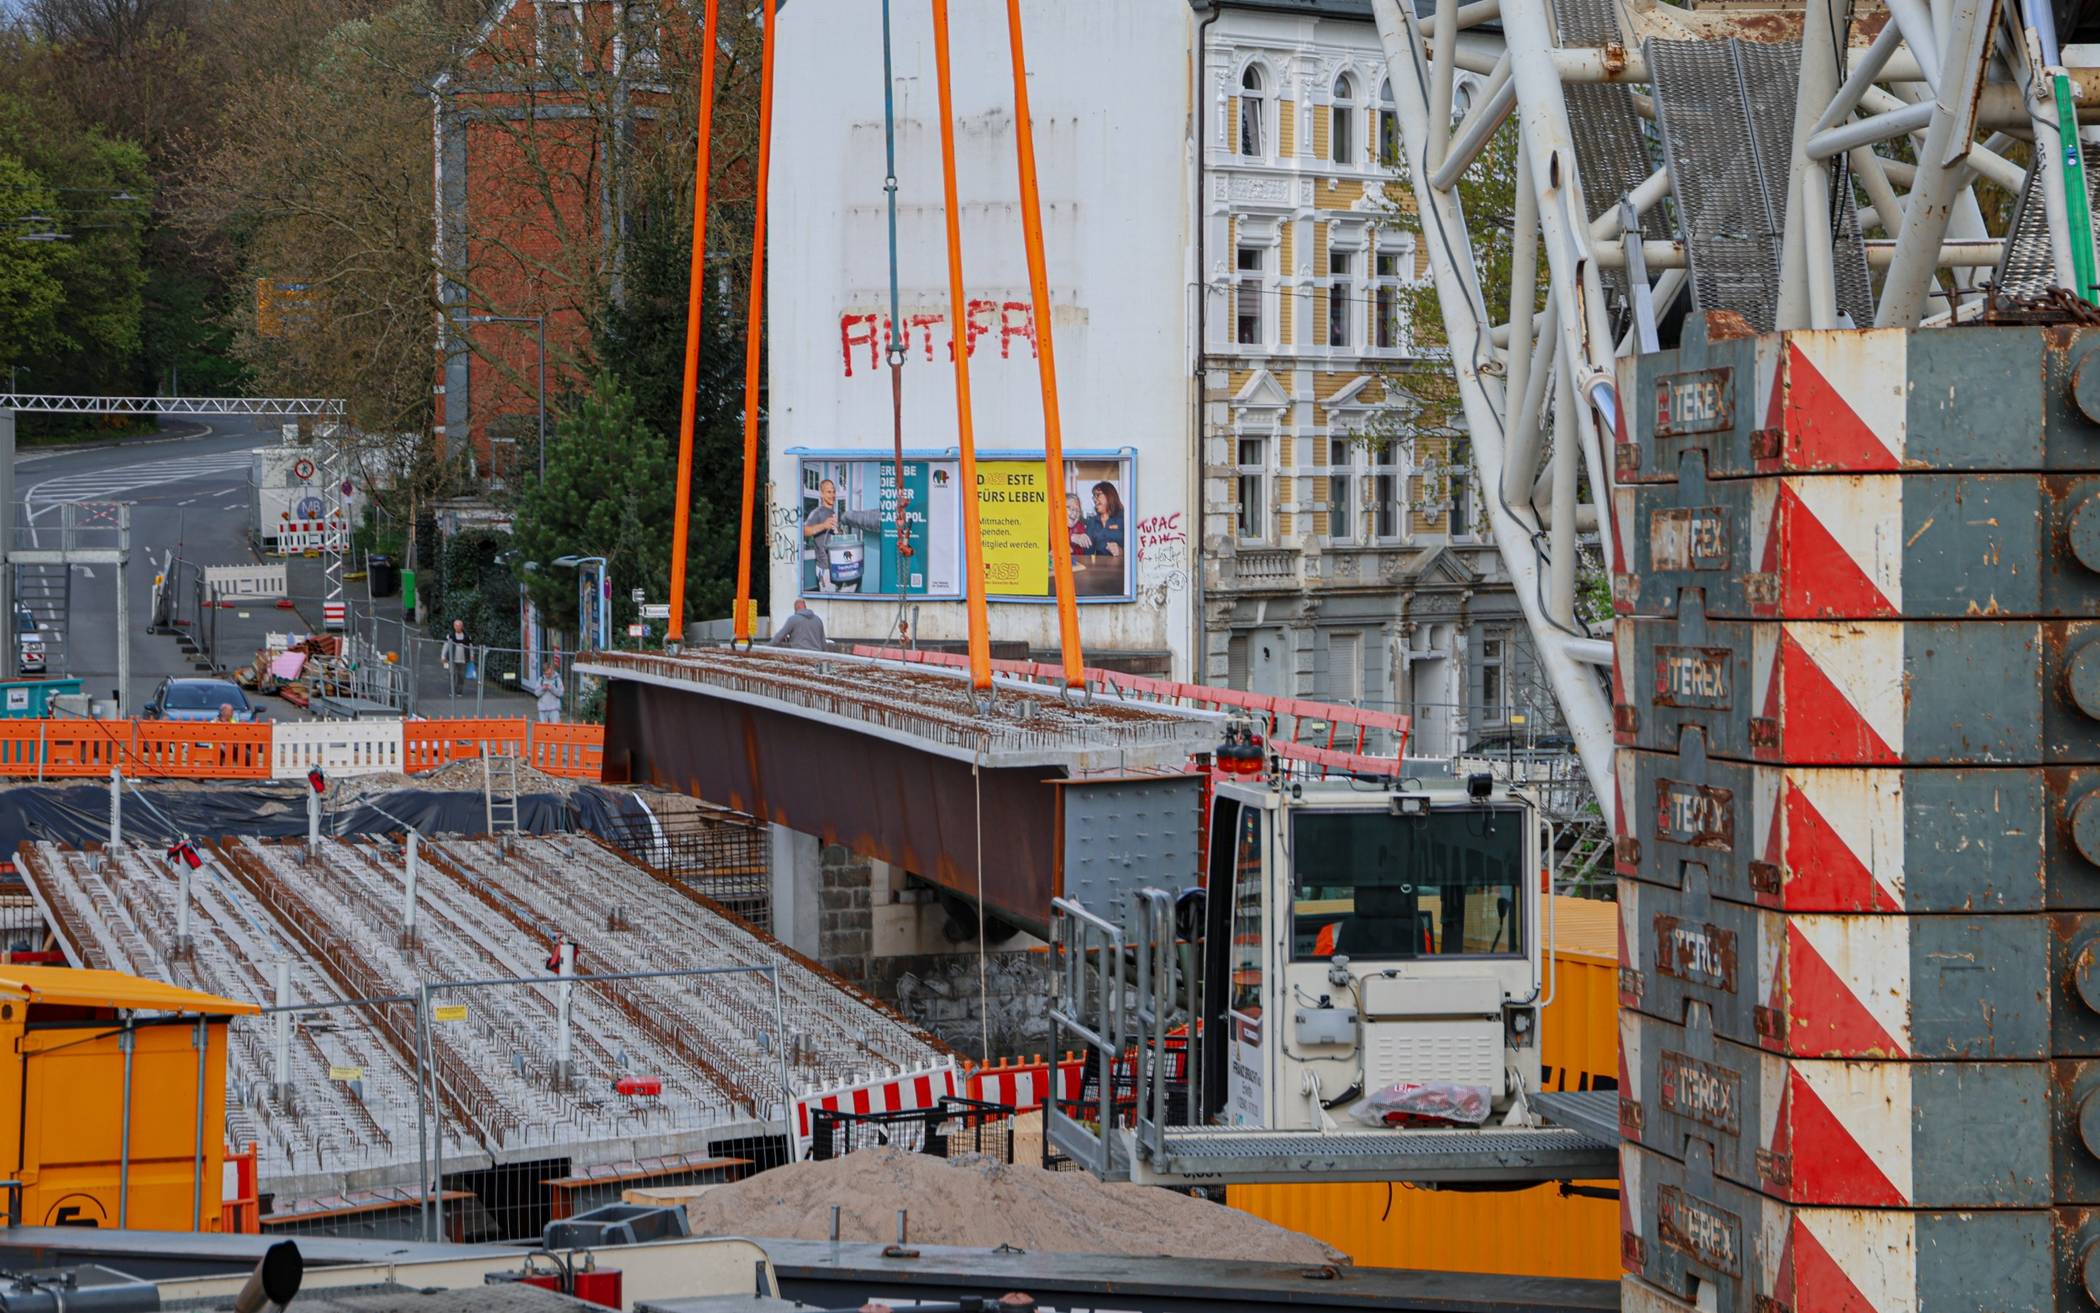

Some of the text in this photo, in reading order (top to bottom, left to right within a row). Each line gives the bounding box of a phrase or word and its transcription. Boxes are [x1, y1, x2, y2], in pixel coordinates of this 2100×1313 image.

[1674, 382, 1726, 422] TEREX
[880, 465, 917, 476] ERLBE
[977, 488, 1045, 503] FÜRS LEBEN
[980, 529, 1011, 537] penden.
[1670, 656, 1724, 697] TEREX
